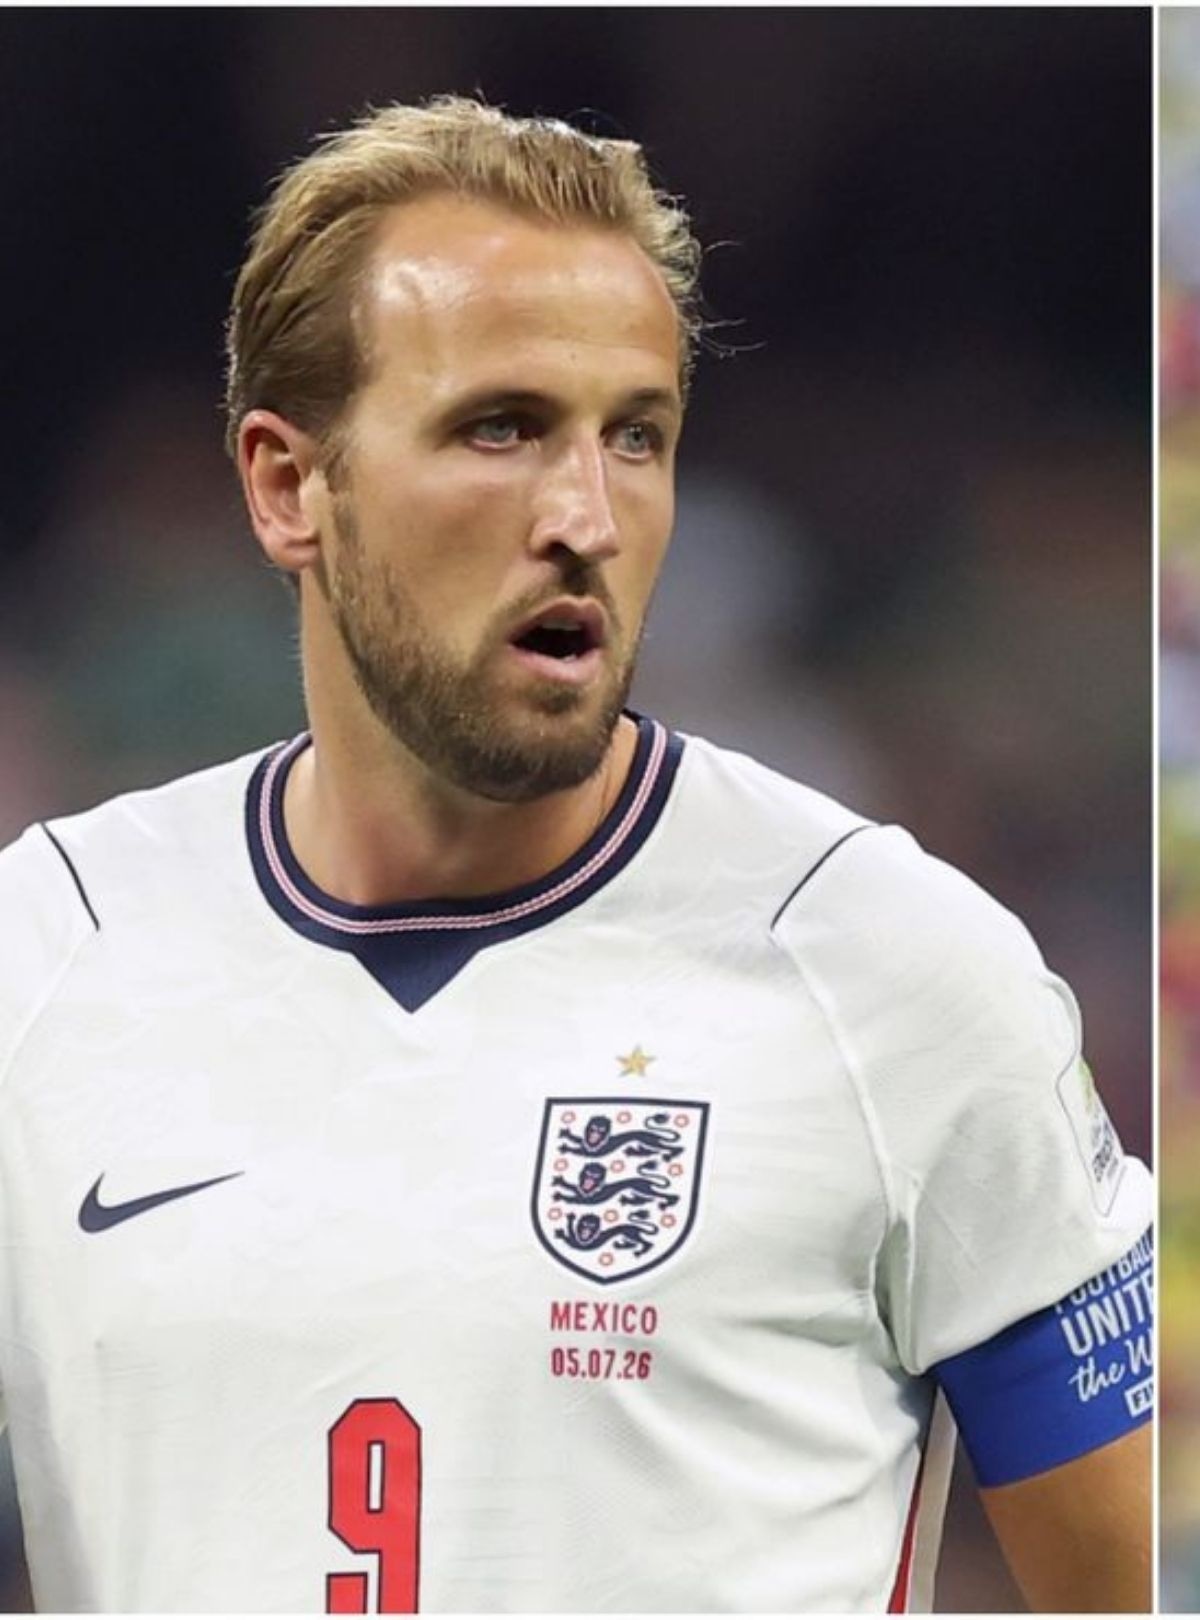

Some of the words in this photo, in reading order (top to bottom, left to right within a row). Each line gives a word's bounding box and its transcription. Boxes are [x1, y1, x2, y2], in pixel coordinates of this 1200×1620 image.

[550, 1302, 658, 1334] MEXICO
[551, 1348, 652, 1379] 05.07.26
[1068, 1356, 1126, 1403] the
[326, 1398, 422, 1613] 9
